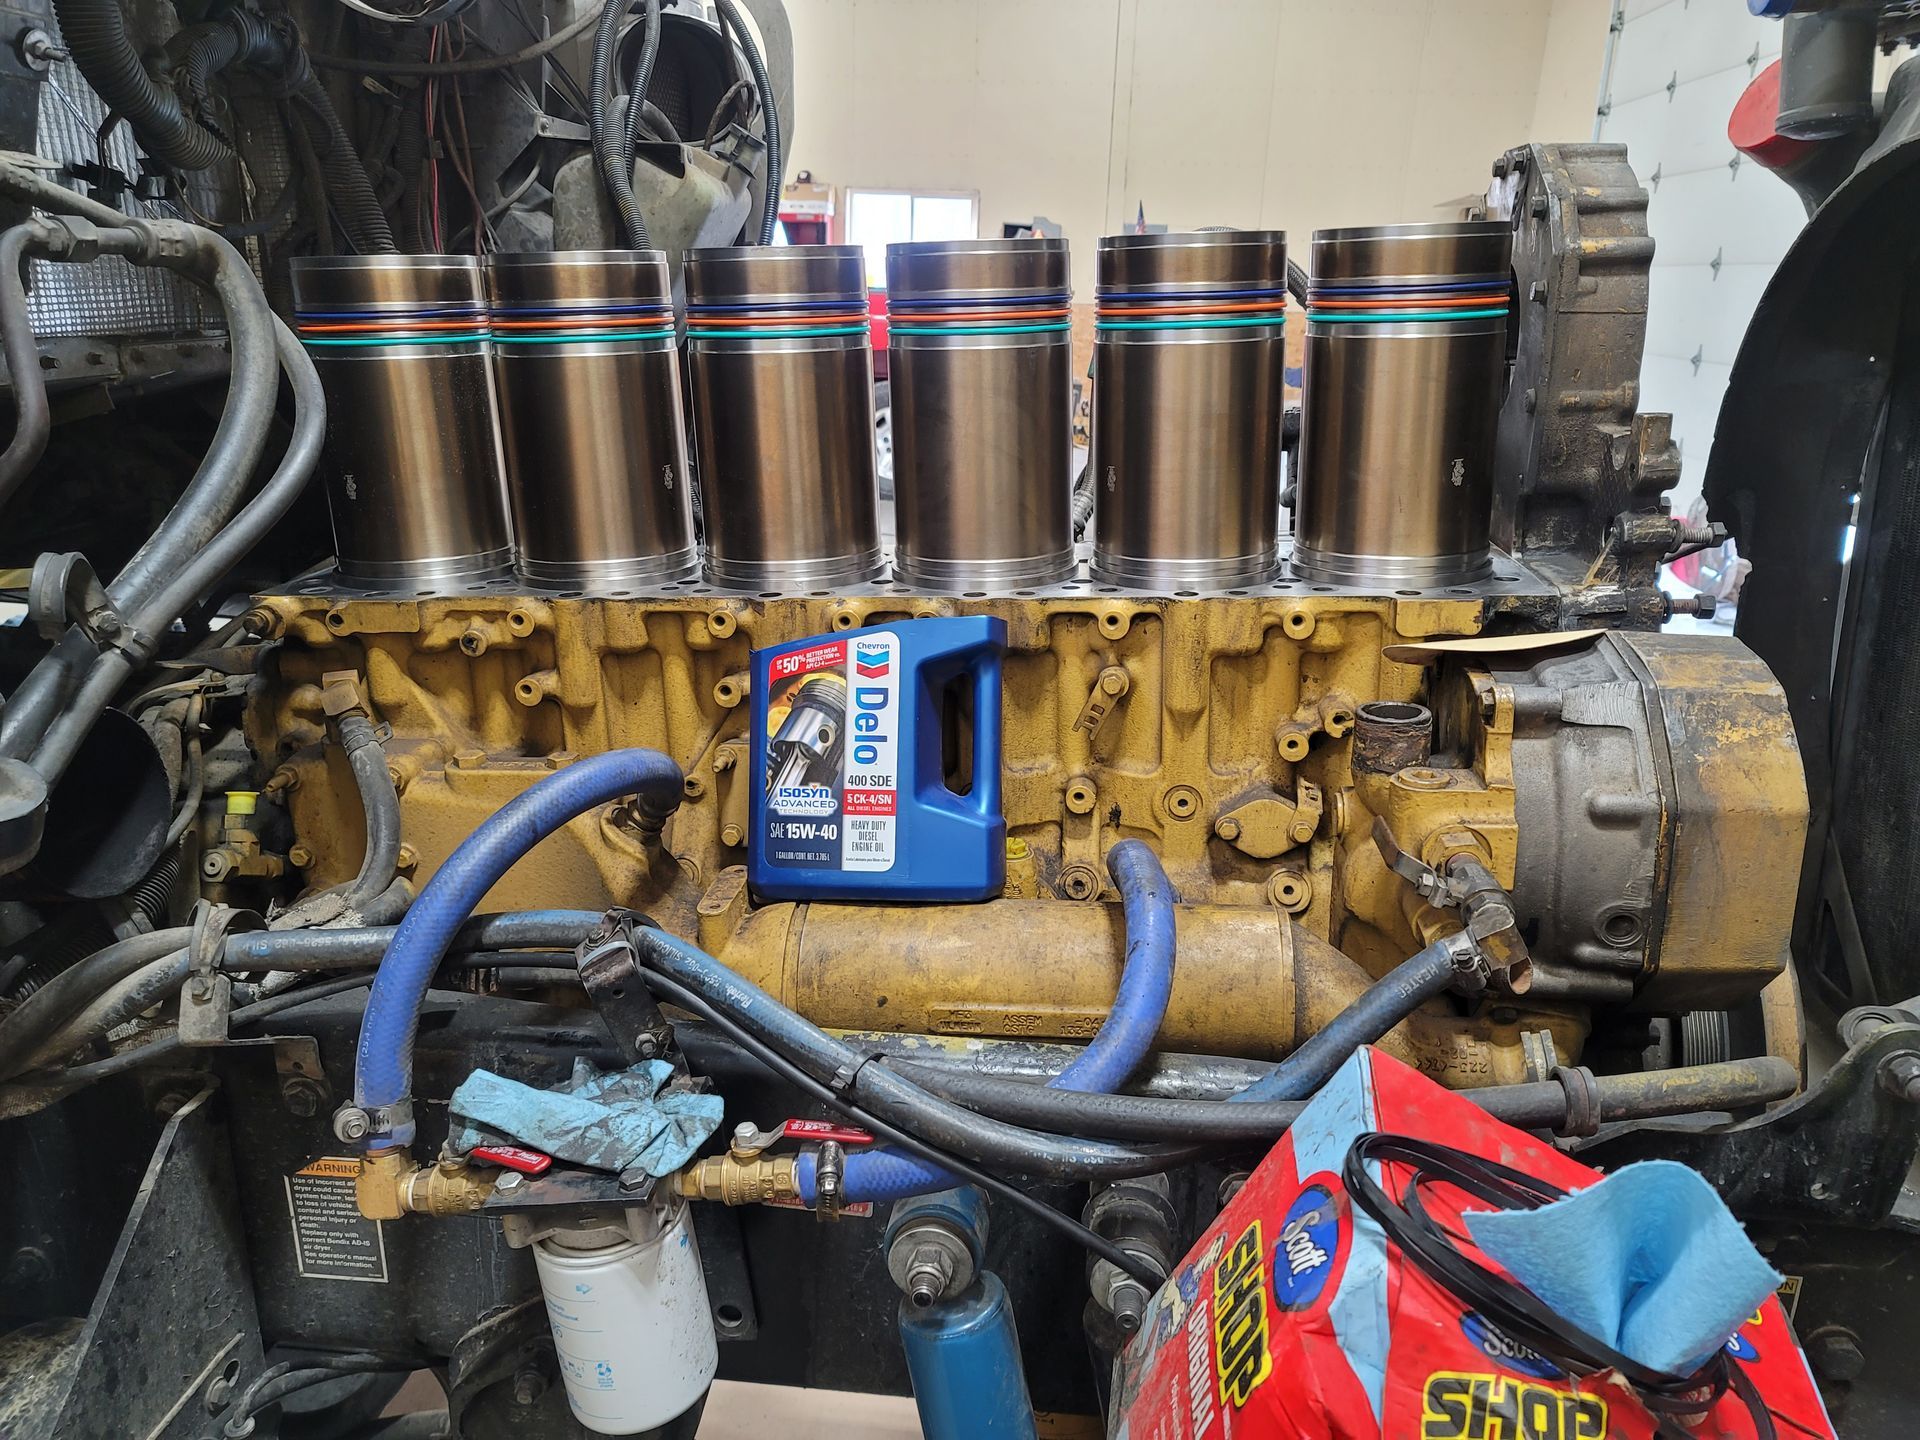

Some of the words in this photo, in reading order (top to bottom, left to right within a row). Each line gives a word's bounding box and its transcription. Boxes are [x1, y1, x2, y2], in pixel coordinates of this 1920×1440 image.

[806, 649, 823, 659] BETTER
[823, 646, 838, 654] WEAR
[857, 642, 890, 650] Chevron
[783, 653, 807, 674] 50%
[805, 653, 834, 663] PROTECTION
[854, 687, 889, 765] Delo
[848, 774, 868, 787] 400
[869, 775, 892, 787] SDE
[772, 799, 836, 809] ADVANCED
[854, 793, 892, 806] CK-4/SN
[770, 822, 785, 839] SAE
[785, 823, 838, 840] 15W-40
[851, 820, 870, 831] HEAVY
[871, 820, 887, 831] DUTY
[858, 831, 878, 841] DIESEL
[851, 842, 873, 852] ENGINE
[874, 842, 884, 853] OIL
[1002, 1014, 1043, 1027] ASSEM
[1003, 1024, 1035, 1035] CSTG
[1060, 1025, 1099, 1038] 133-0
[328, 1216, 348, 1224] injury
[301, 1228, 328, 1236] Replace
[1282, 1210, 1329, 1276] Scott
[318, 1252, 352, 1260] operator's
[1214, 1220, 1271, 1406] SHOP
[1480, 1318, 1543, 1361] Sco
[1424, 1376, 1606, 1440] SHOP
